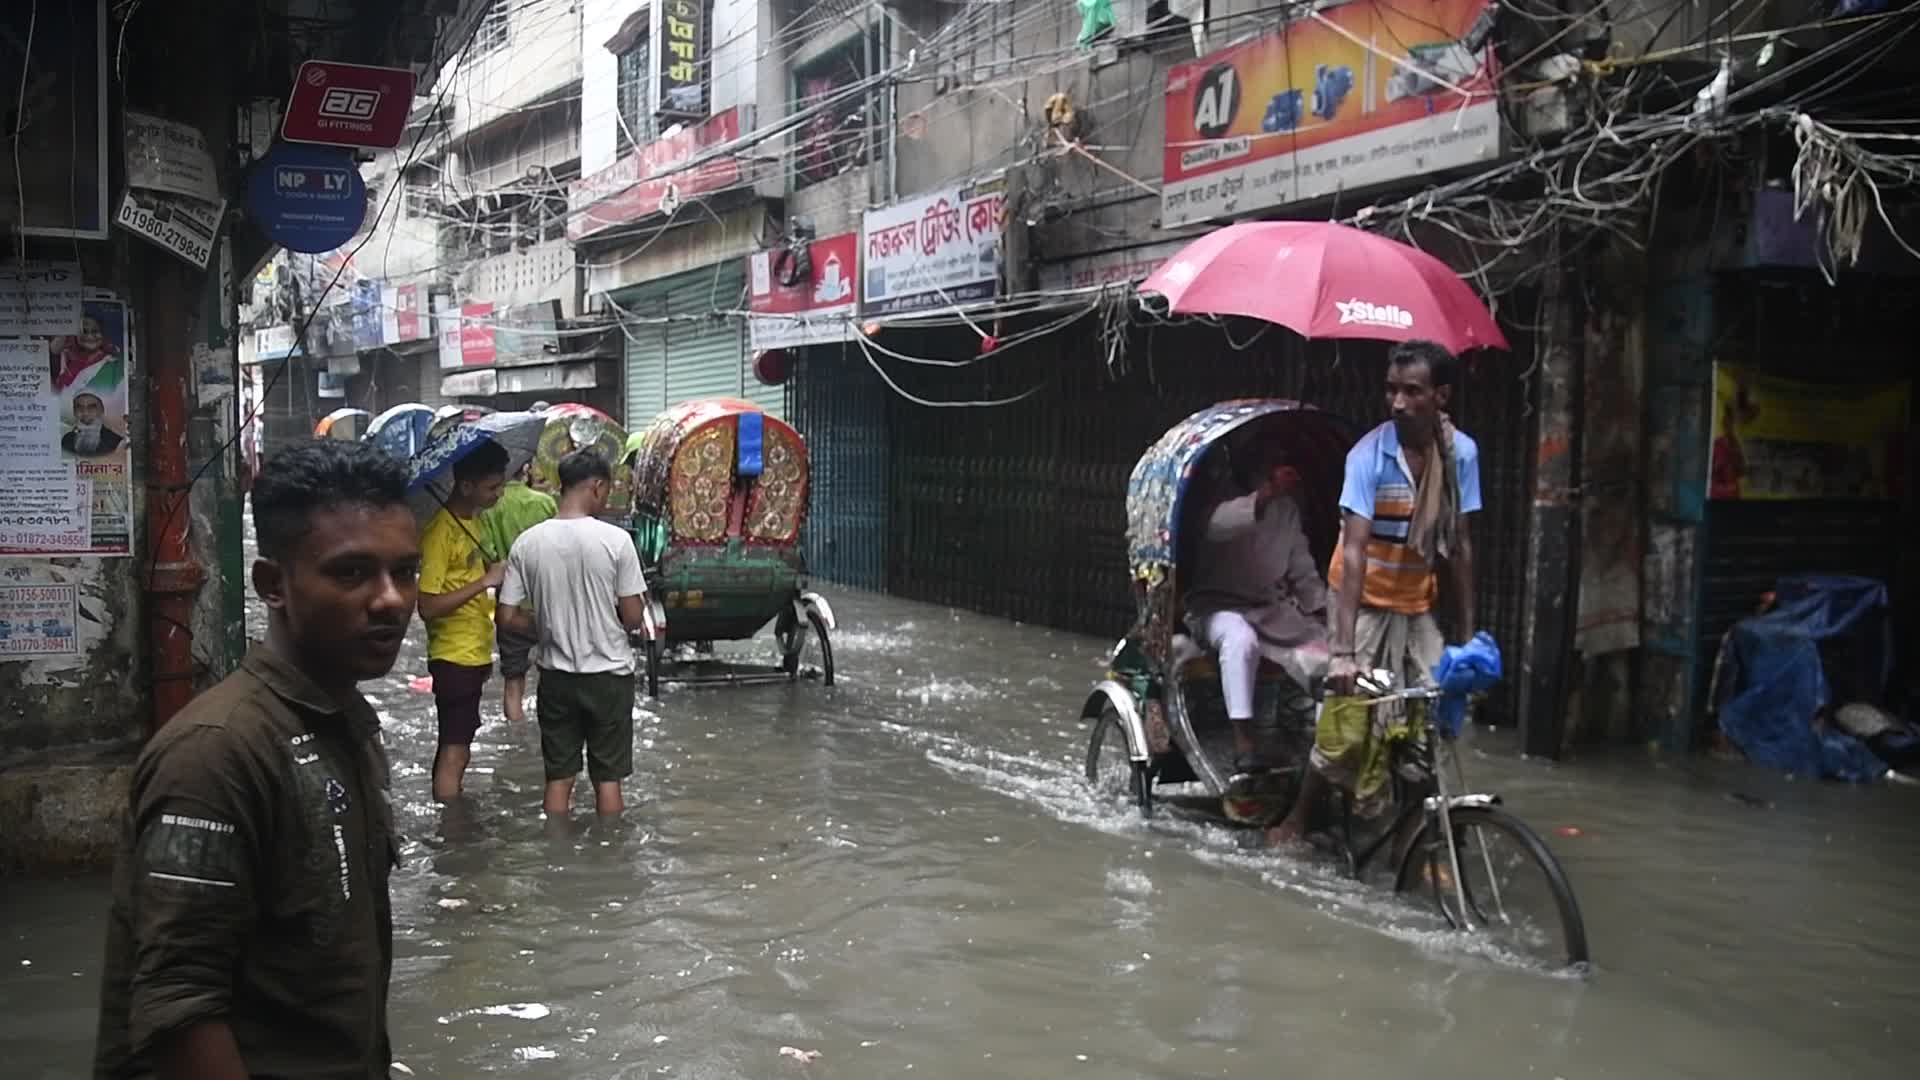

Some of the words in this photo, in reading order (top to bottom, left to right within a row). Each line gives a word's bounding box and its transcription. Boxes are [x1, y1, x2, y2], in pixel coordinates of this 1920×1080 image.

[1194, 68, 1235, 132] A1
[1183, 146, 1220, 166] Quality
[279, 171, 346, 191] NPLY
[121, 205, 209, 264] 01980-279845
